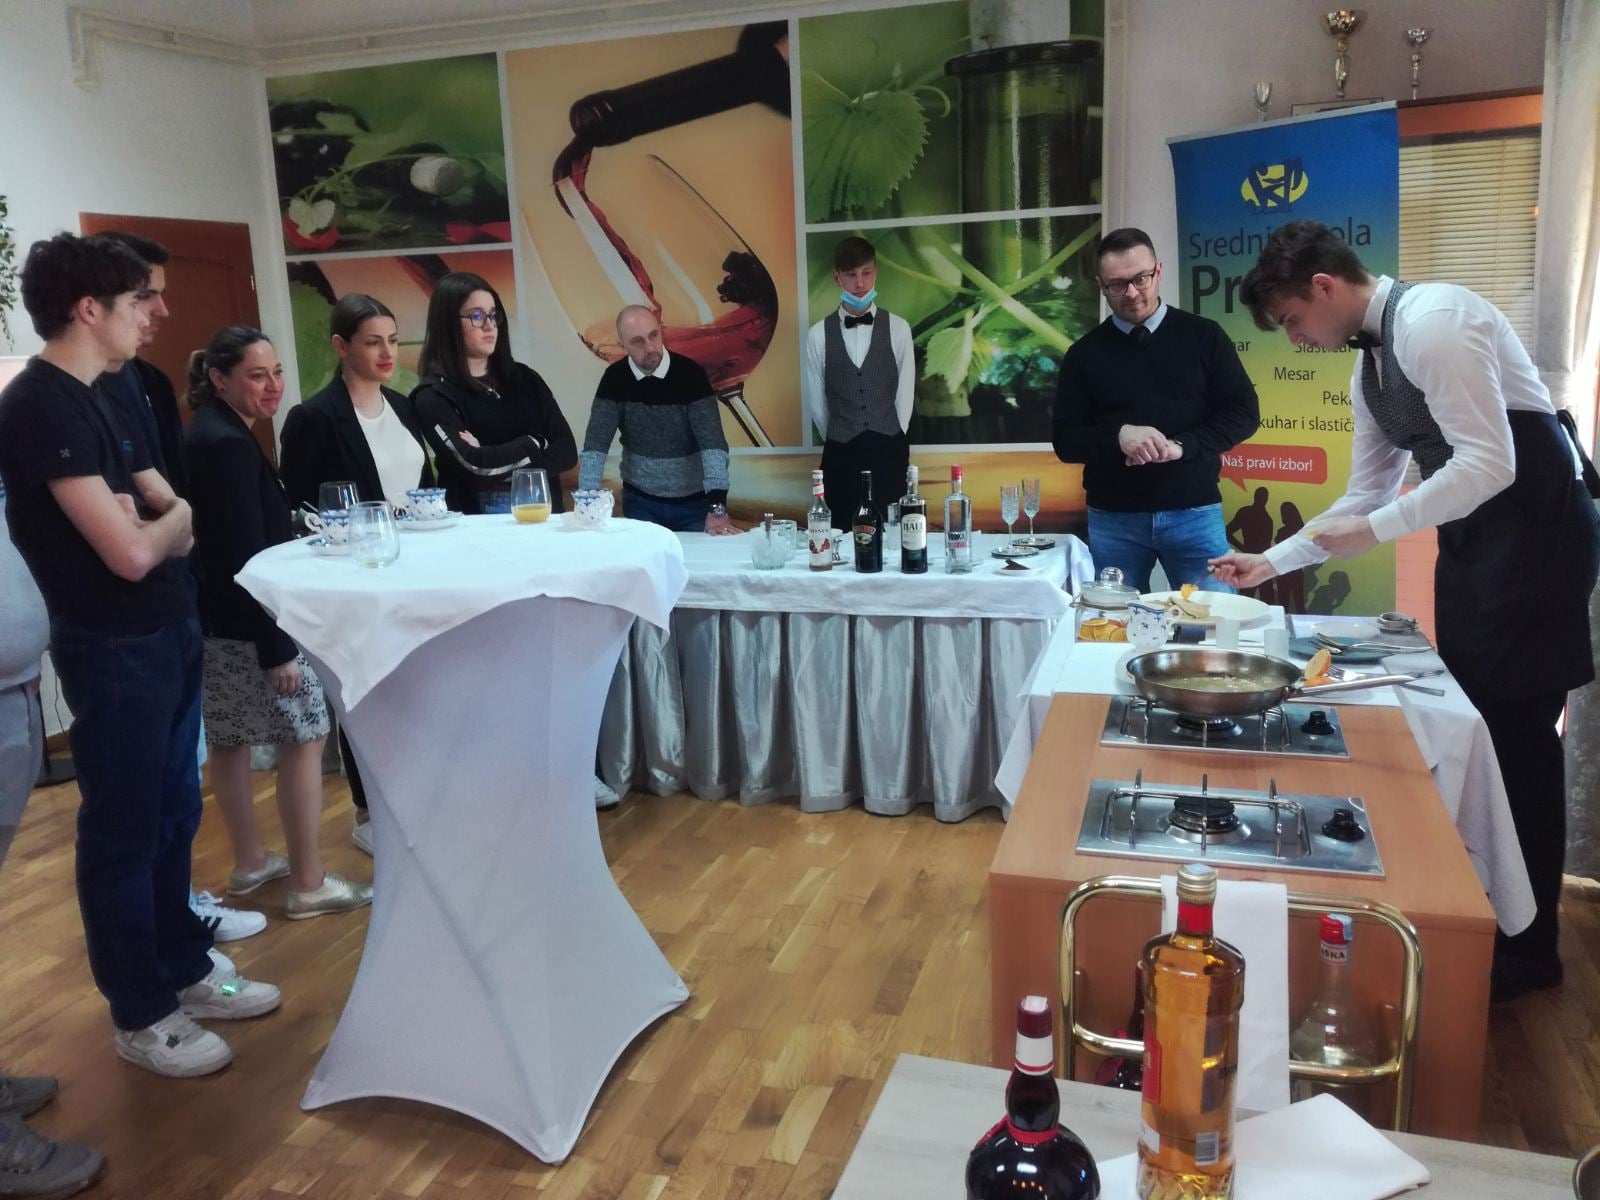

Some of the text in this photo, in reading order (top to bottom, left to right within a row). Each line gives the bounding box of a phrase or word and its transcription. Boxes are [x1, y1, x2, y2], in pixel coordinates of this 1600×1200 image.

[1274, 366, 1316, 381] Mesar
[1322, 390, 1352, 406] Pek
[1221, 454, 1313, 474] Naš pravi izbor!
